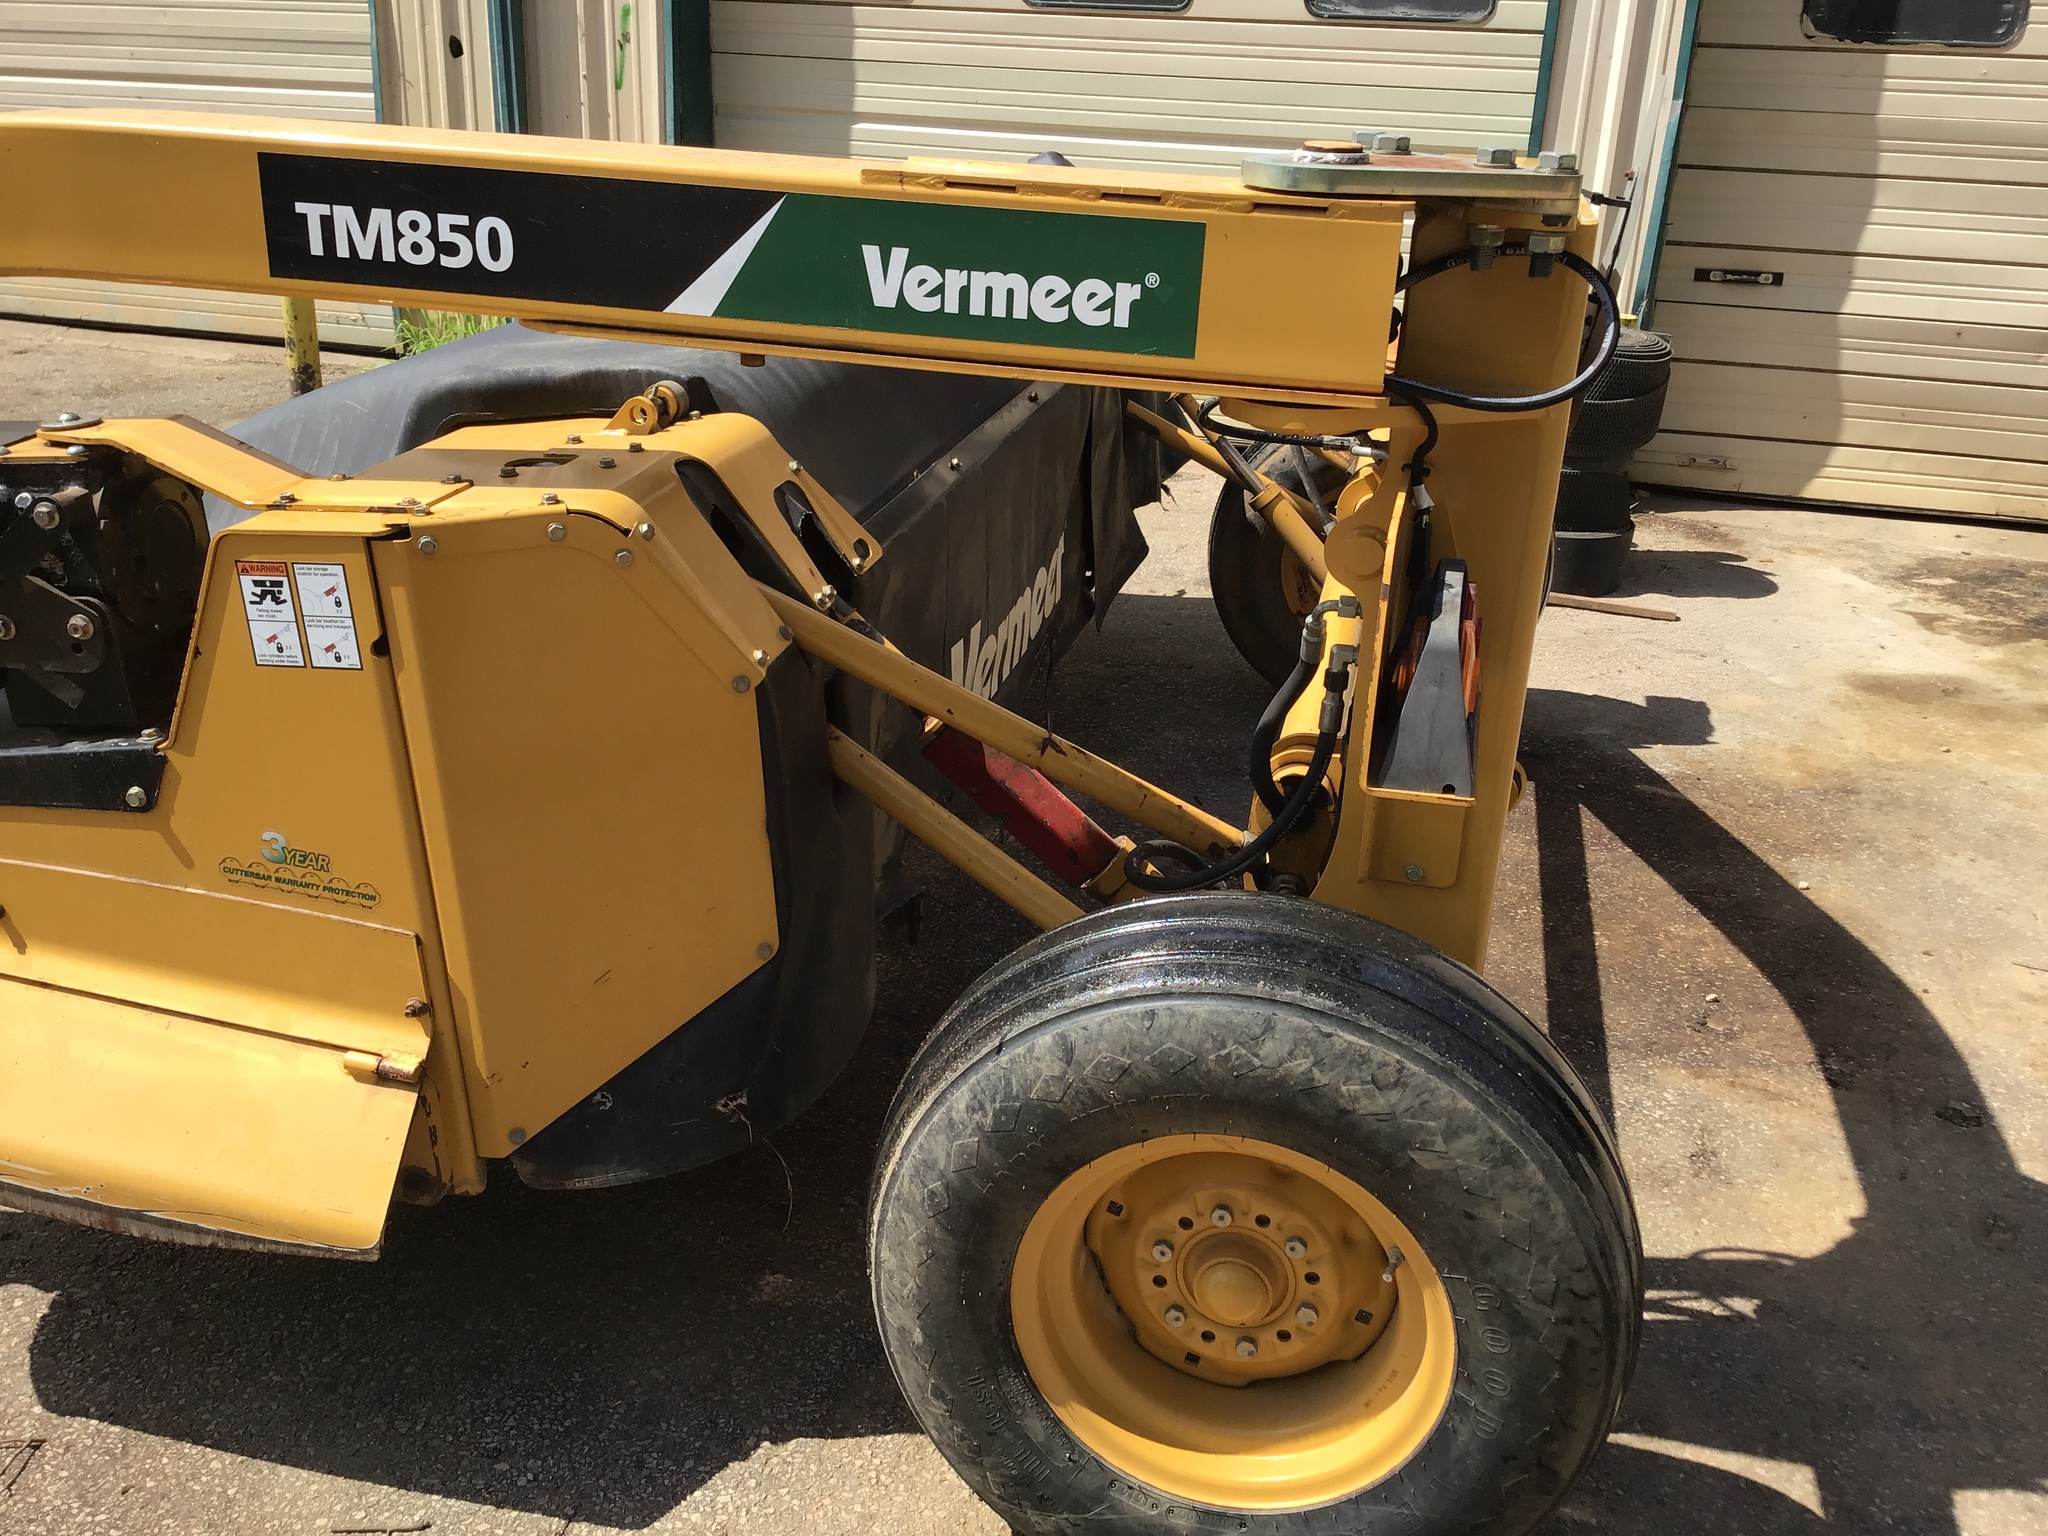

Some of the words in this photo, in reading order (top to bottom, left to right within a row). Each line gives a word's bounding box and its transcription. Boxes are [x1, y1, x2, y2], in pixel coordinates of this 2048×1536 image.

[294, 201, 514, 273] TM850
[249, 564, 285, 574] WARNING
[261, 831, 286, 864] 3
[282, 847, 331, 872] YEAR
[223, 866, 272, 882] CUTTERBAR
[274, 875, 321, 892] WARRANTY
[322, 885, 377, 902] PROTECTION
